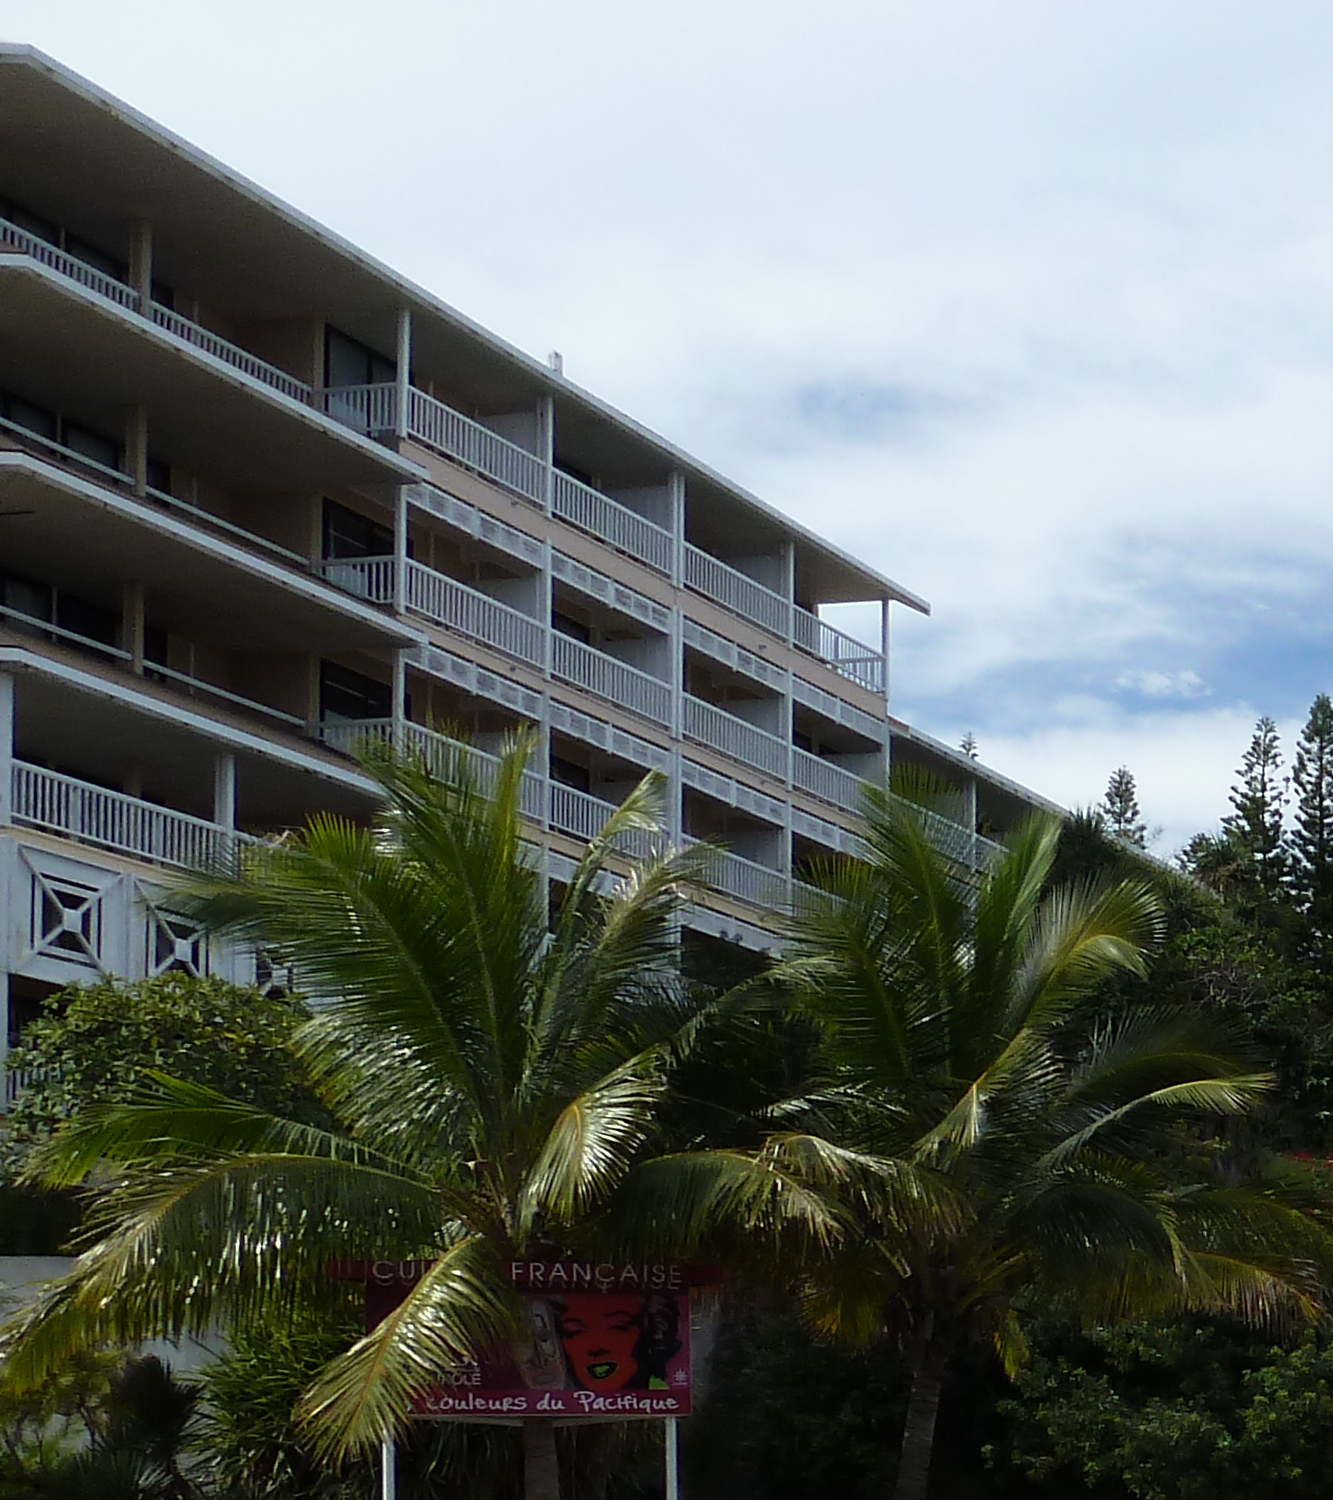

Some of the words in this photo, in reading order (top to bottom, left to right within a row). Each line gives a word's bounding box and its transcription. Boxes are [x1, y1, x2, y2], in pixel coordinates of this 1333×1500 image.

[511, 1261, 682, 1286] FRANÇAISE
[536, 1392, 566, 1411] du
[573, 1390, 680, 1413] Pacifique
